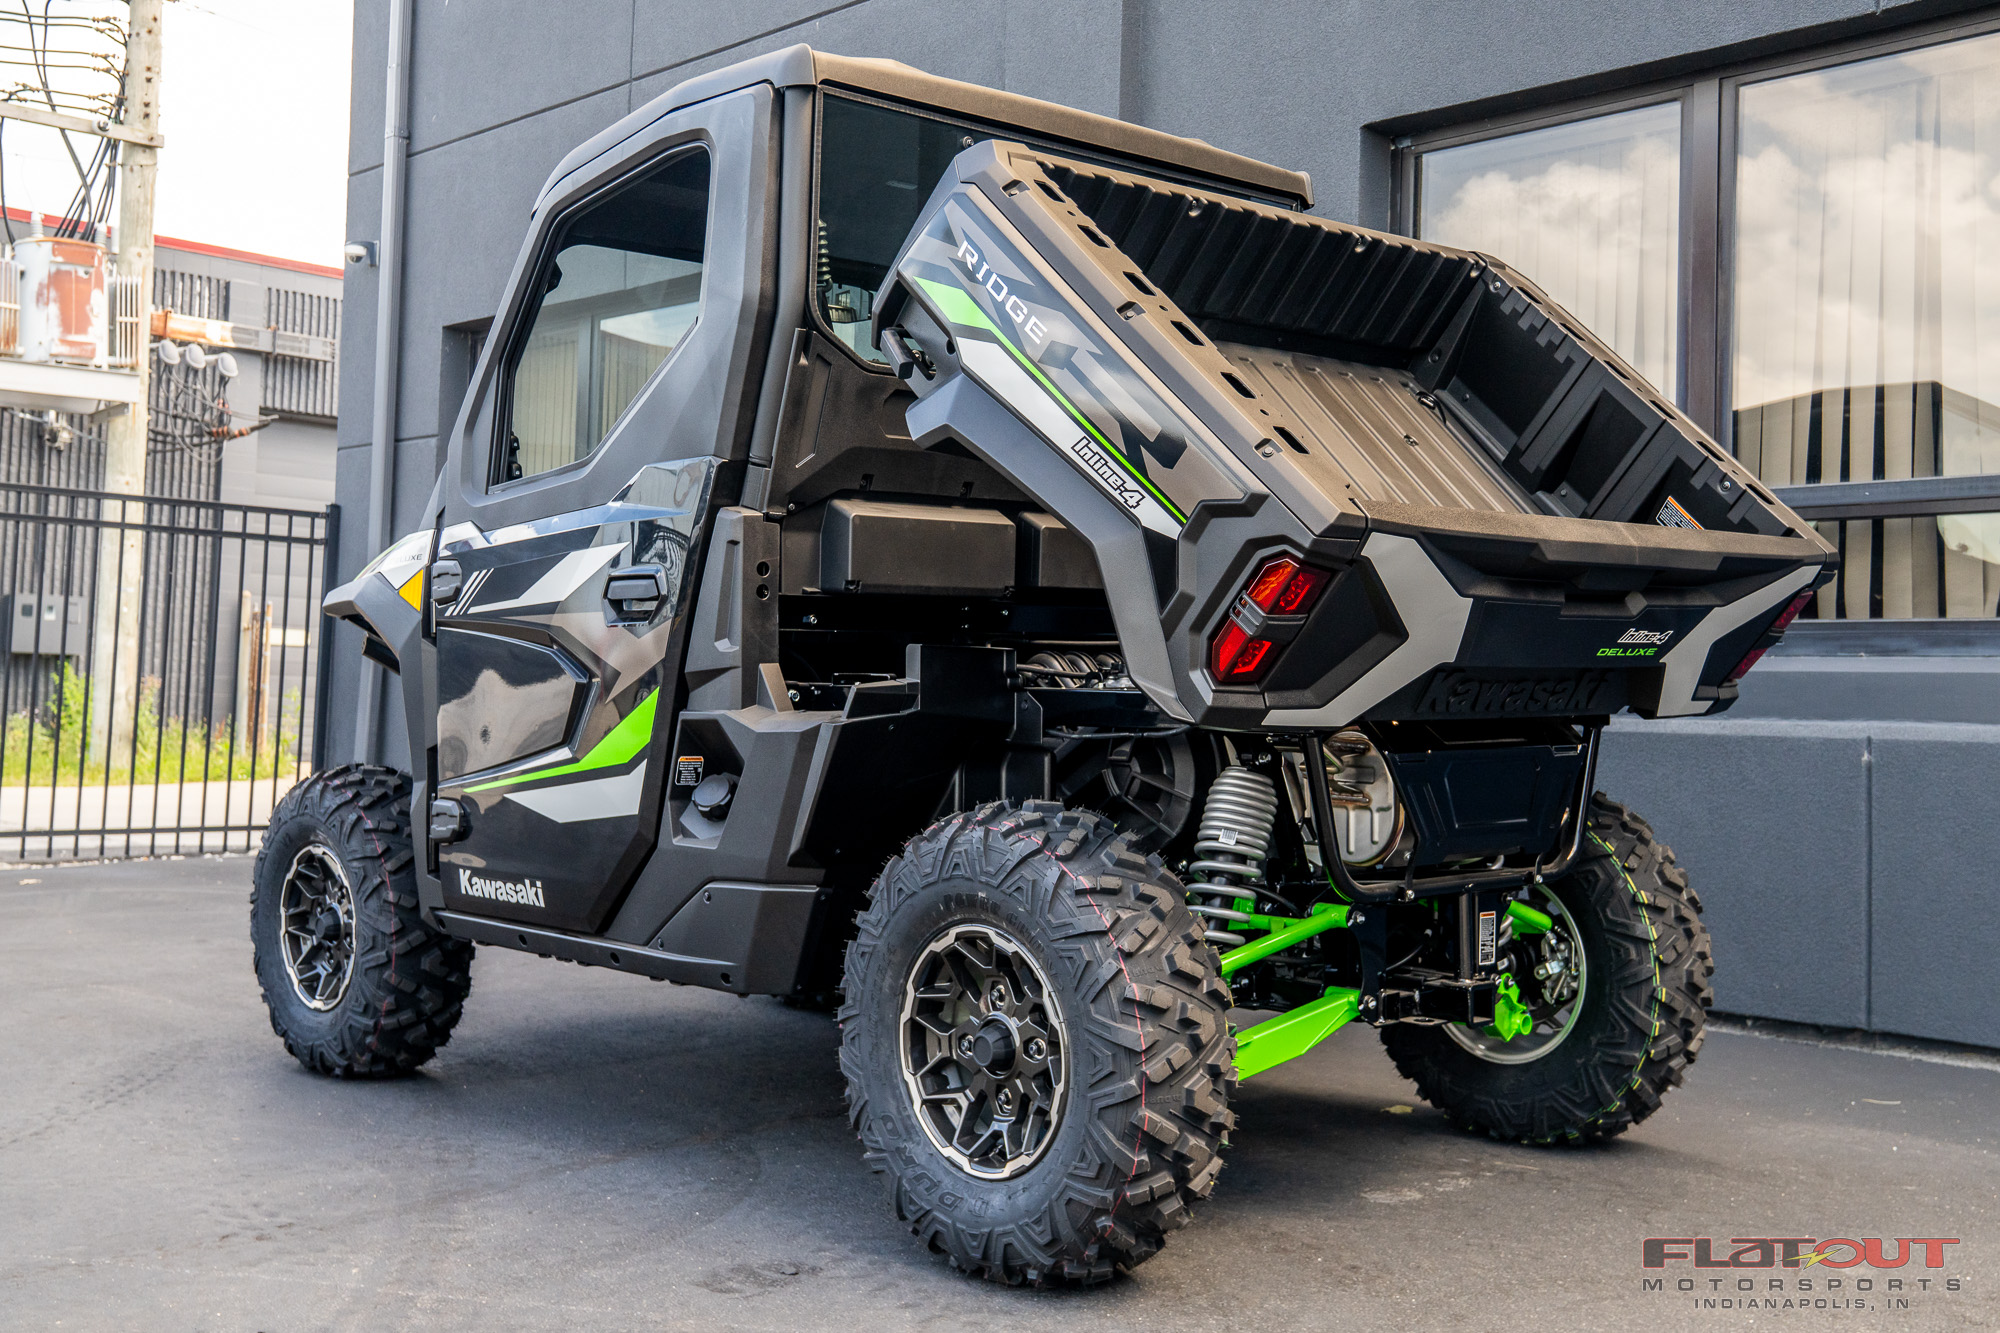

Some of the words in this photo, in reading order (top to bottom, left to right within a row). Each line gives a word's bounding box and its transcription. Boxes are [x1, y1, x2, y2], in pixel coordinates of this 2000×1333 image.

[956, 240, 1048, 344] RIDGE
[1070, 436, 1146, 509] Inline-4
[1597, 647, 1658, 657] DELUXE
[1617, 628, 1674, 645] Inline-4
[1414, 667, 1614, 713] Kawasaki
[459, 868, 545, 907] Kawasaki
